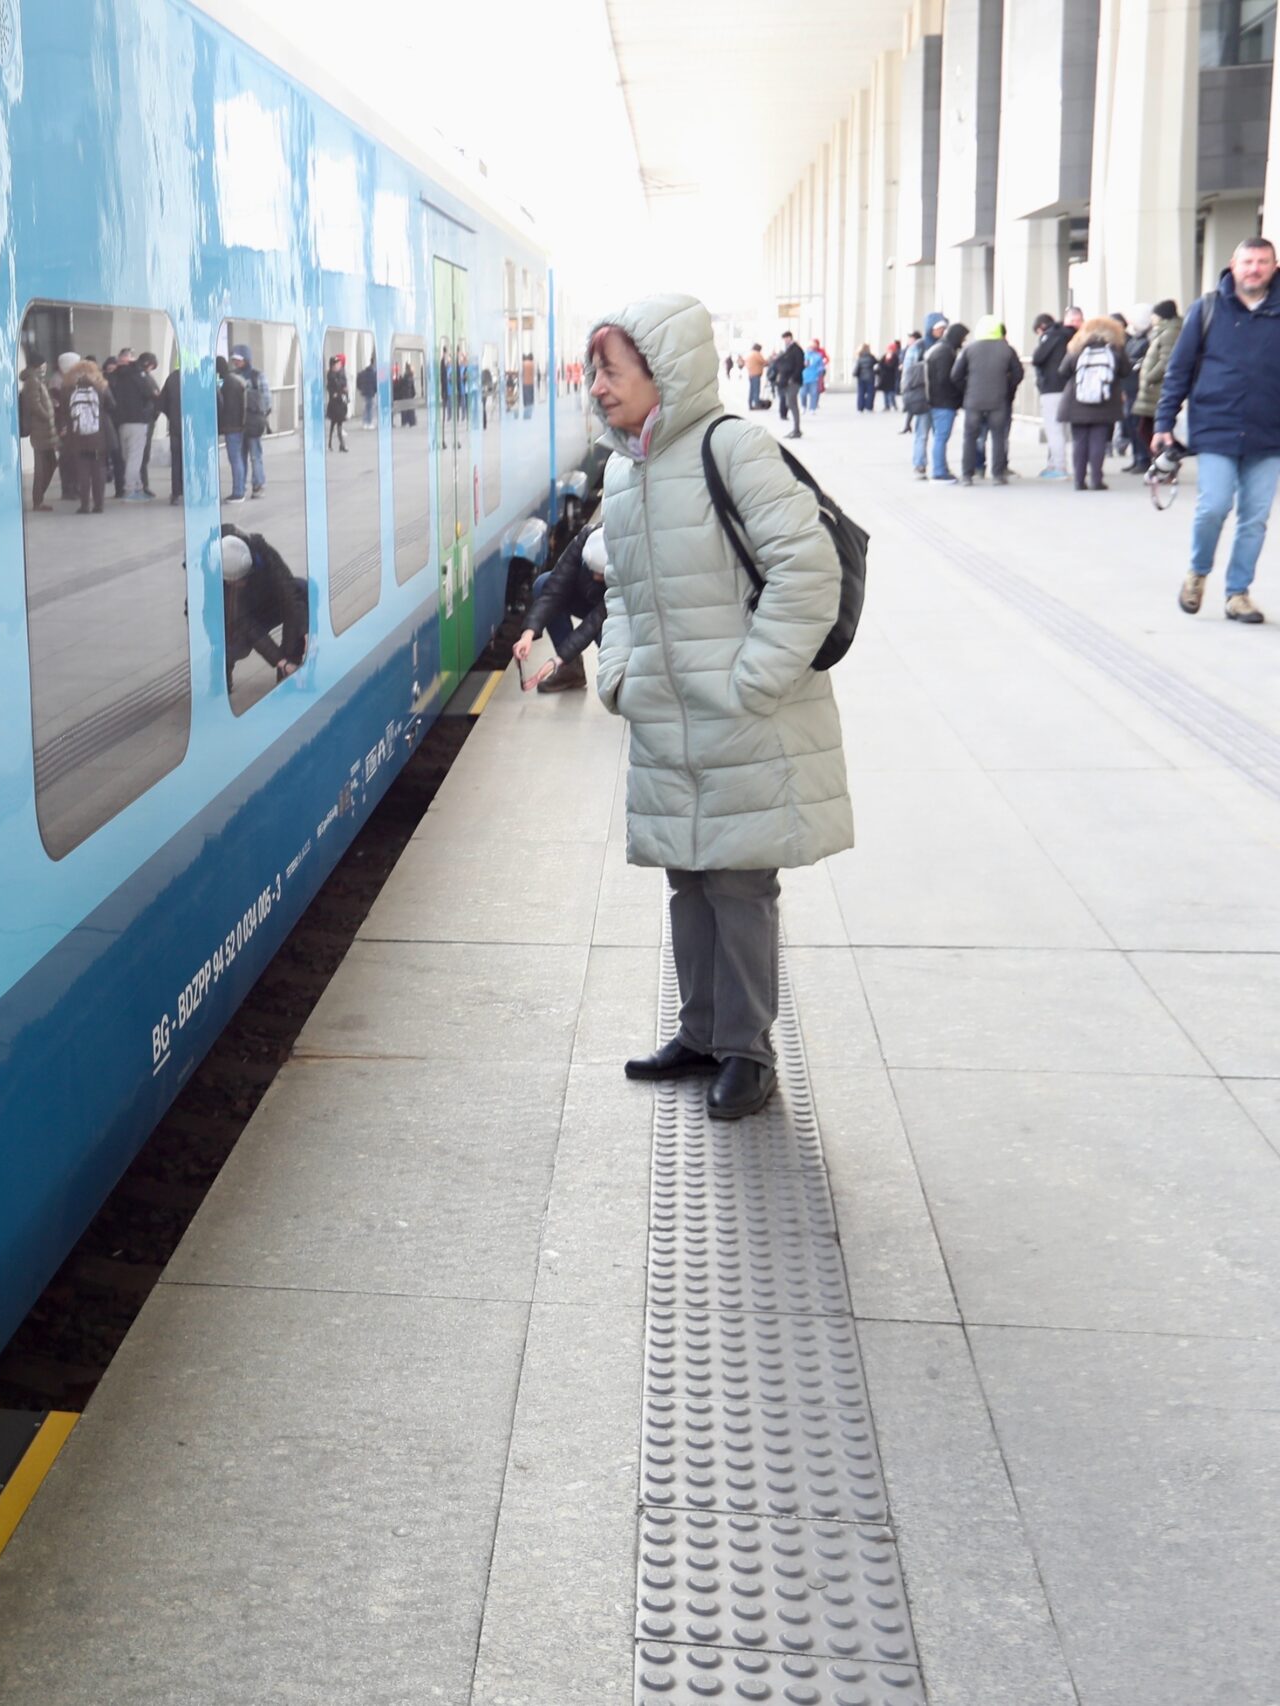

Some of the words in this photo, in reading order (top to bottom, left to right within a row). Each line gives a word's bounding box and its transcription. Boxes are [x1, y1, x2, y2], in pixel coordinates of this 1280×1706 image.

[152, 1013, 170, 1065] BG
[178, 958, 212, 1030] BDZPP
[213, 944, 224, 983] 94
[225, 930, 236, 967] 52
[236, 921, 243, 952] 0
[243, 902, 258, 943] 034
[276, 872, 282, 902] 3
